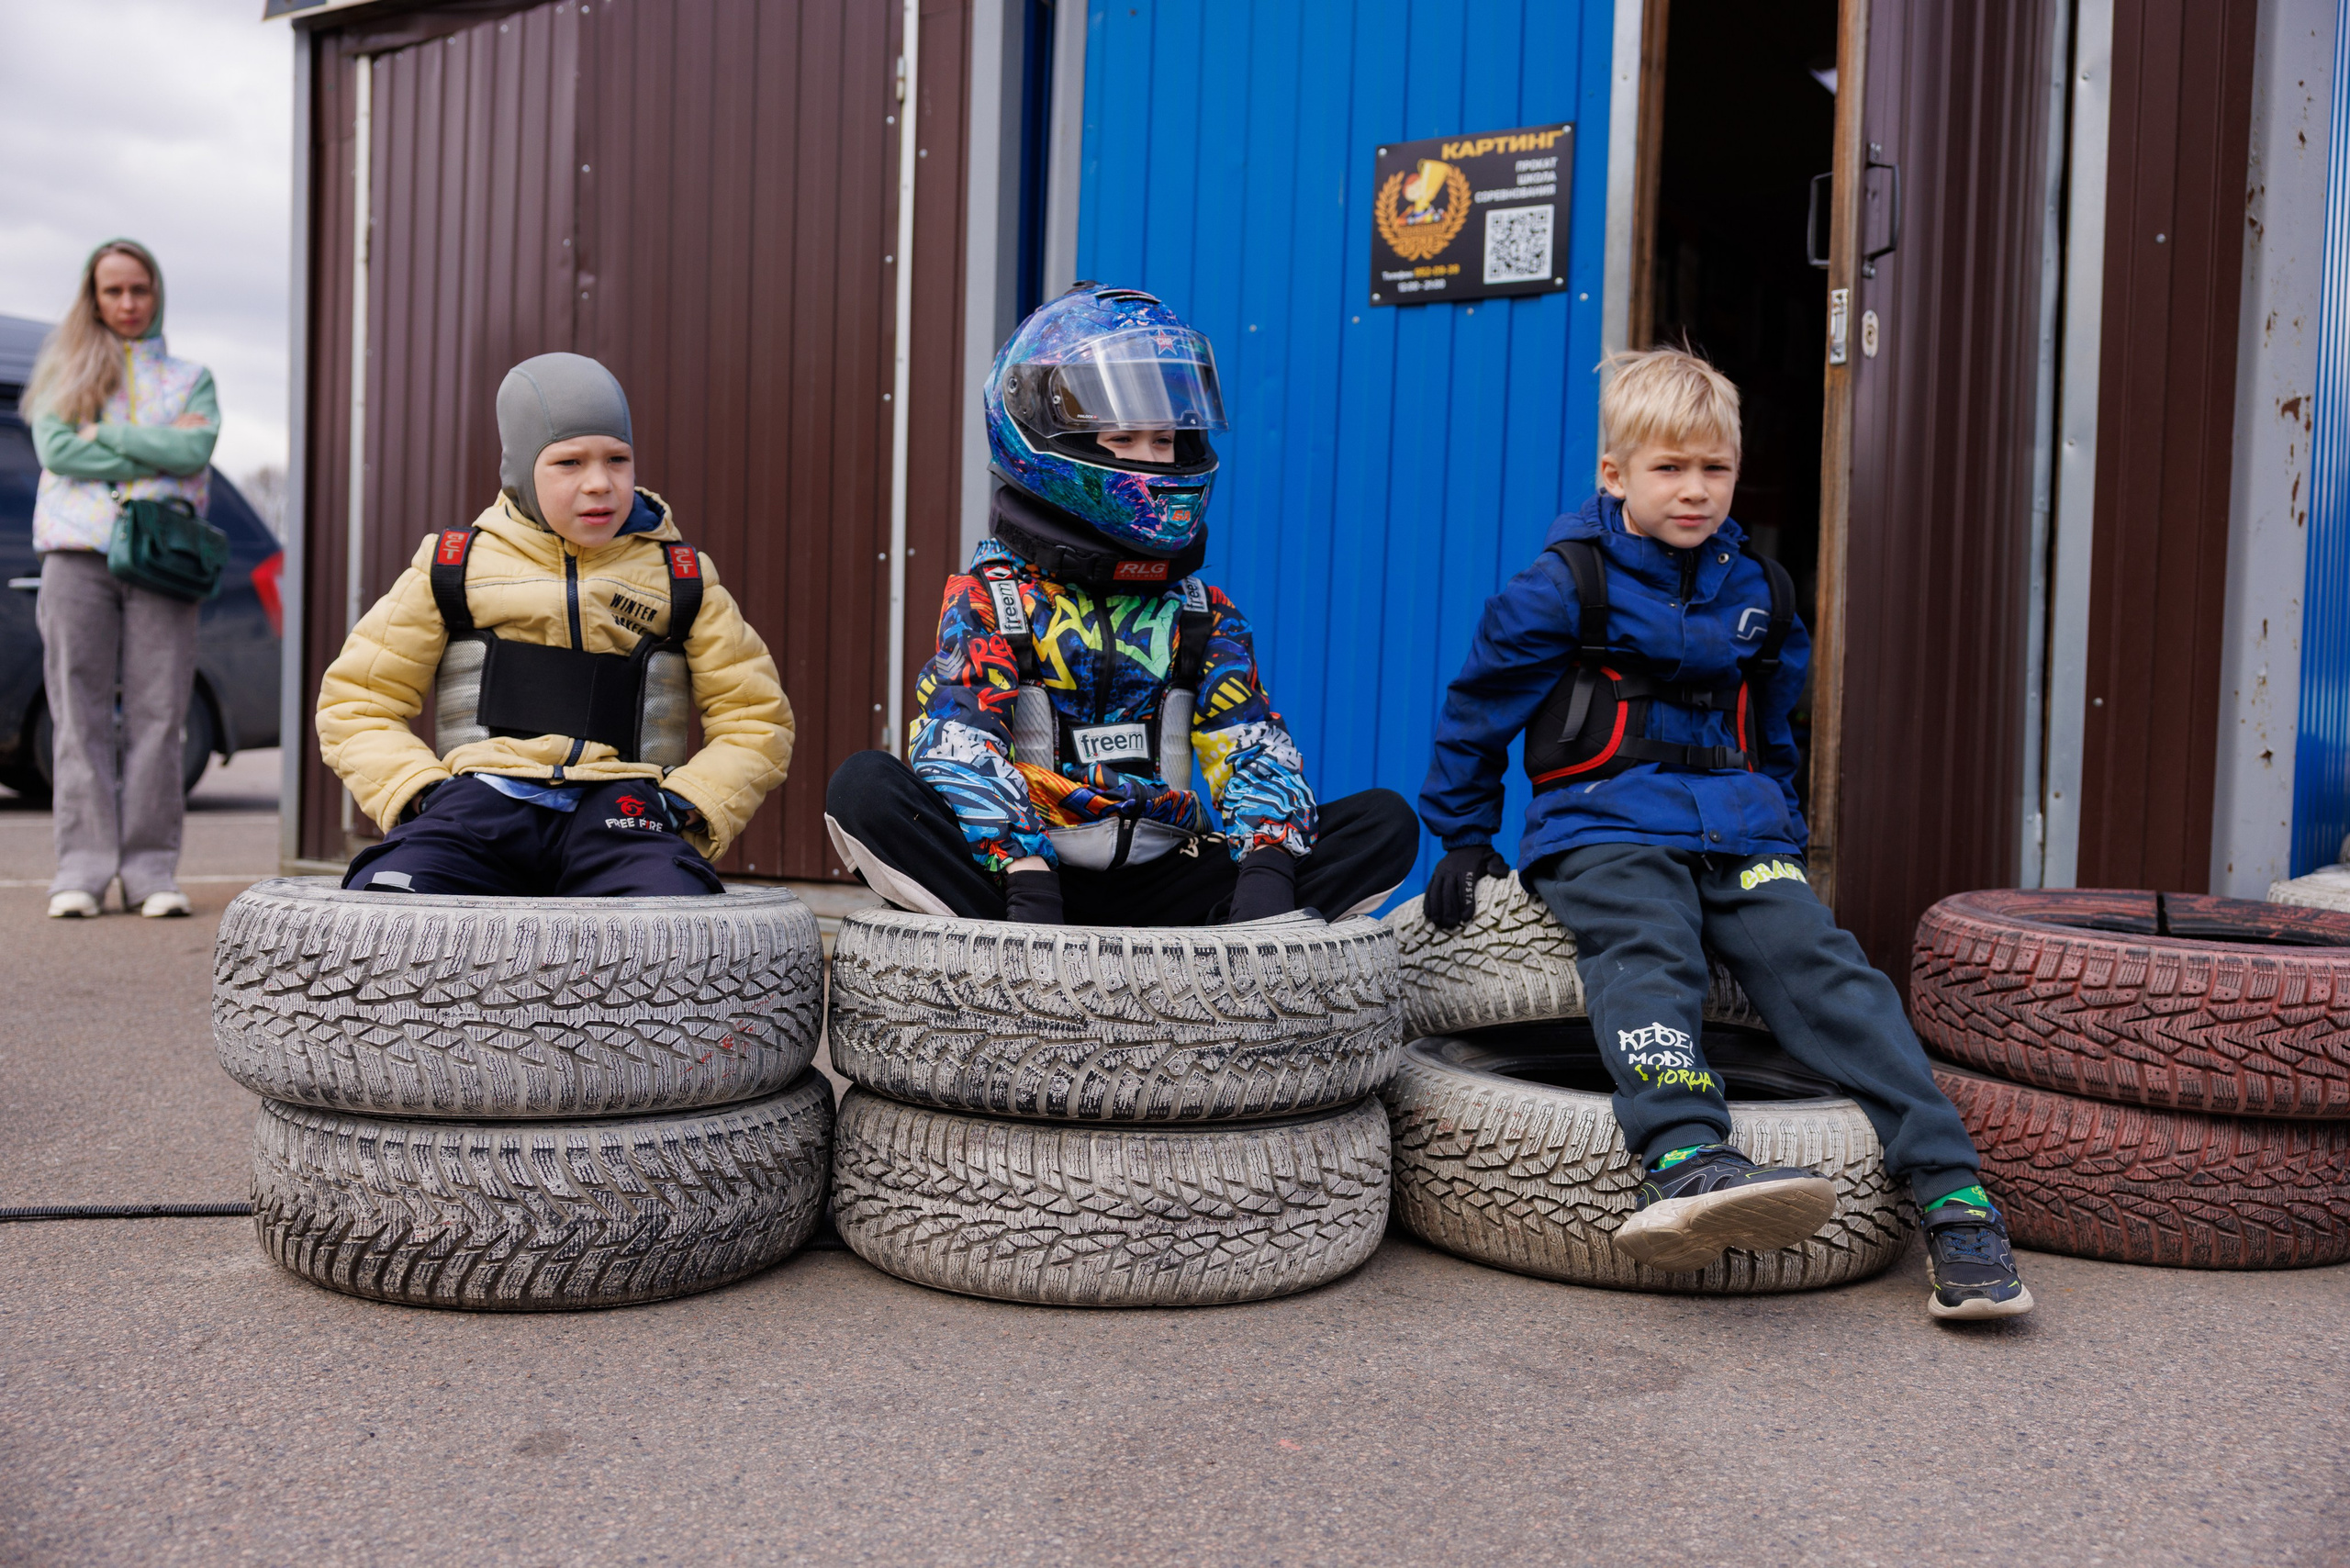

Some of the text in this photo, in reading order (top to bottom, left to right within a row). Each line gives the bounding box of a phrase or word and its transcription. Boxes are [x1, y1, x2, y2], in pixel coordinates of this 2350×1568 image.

[1441, 129, 1563, 160] КАРТИНГ
[1516, 156, 1559, 172] ПРОКАТ
[1516, 171, 1558, 185] ШКОЛА
[1120, 563, 1167, 574] RLG
[610, 593, 658, 622] WINTER
[998, 582, 1024, 632] freem
[1080, 733, 1144, 757] freem
[605, 816, 663, 833] FREE FIRE
[1465, 871, 1473, 904] KIPSTA
